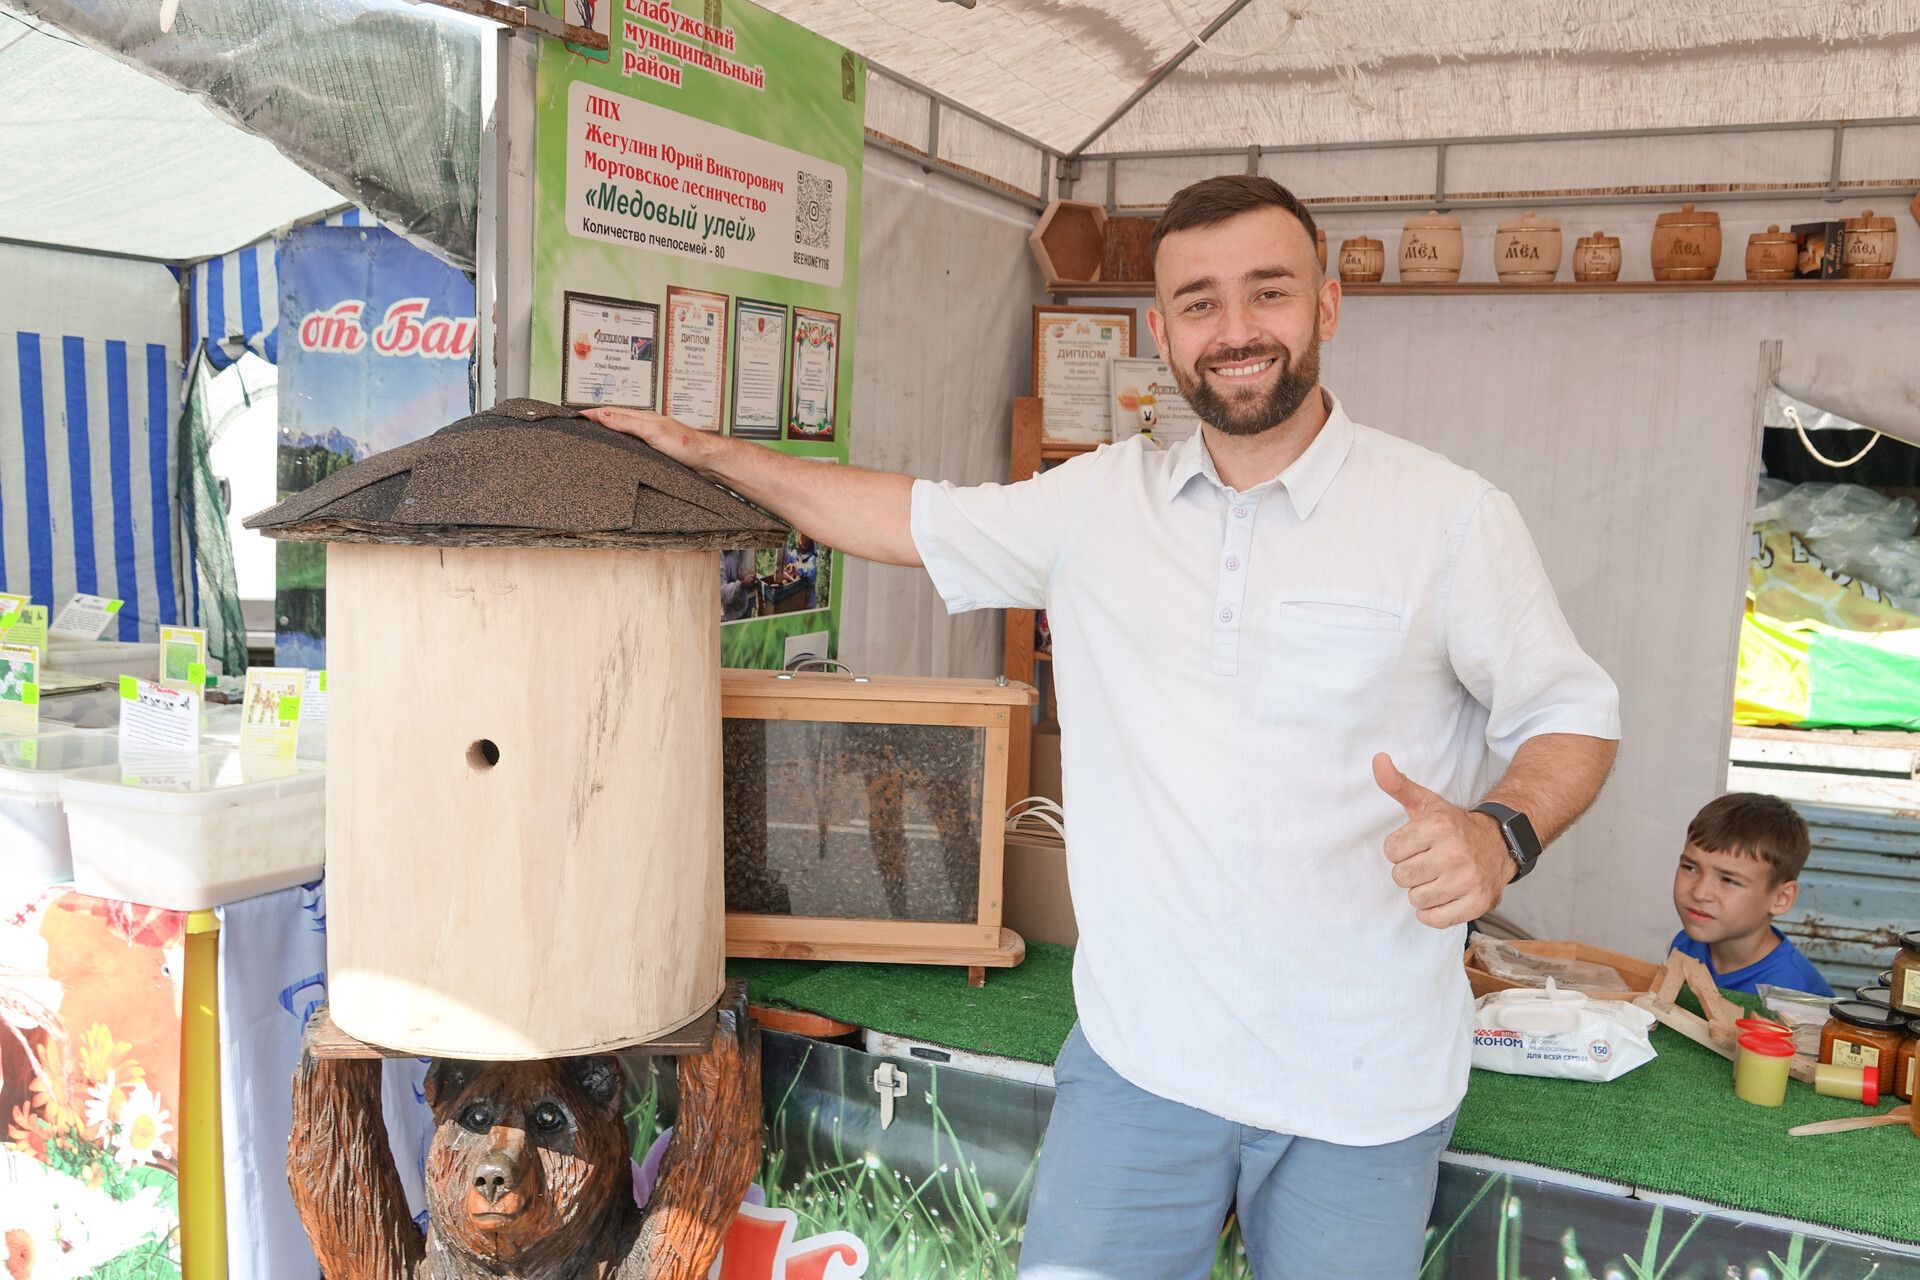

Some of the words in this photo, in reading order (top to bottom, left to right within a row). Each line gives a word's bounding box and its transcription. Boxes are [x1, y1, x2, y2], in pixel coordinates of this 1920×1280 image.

[624, 51, 681, 85] район
[625, 22, 764, 89] муниципальный
[585, 95, 621, 121] ЛПХ
[585, 122, 658, 159] Жегулин
[661, 143, 703, 172] Юрий
[706, 157, 784, 194] Викторович
[584, 150, 679, 190] Мортовское
[681, 180, 767, 213] лесничество
[585, 182, 698, 230] «Медовый
[702, 213, 756, 242] улей»
[583, 217, 646, 243] Количество
[649, 233, 707, 257] пчелосемей
[714, 245, 725, 259] 80
[793, 251, 829, 270] BEEHONEY116
[301, 304, 365, 351] от
[680, 333, 710, 345] ДИПЛОМ
[1057, 348, 1106, 360] ДИПЛОМ
[1473, 1036, 1523, 1048] КОНОМ
[1593, 1045, 1608, 1055] 150
